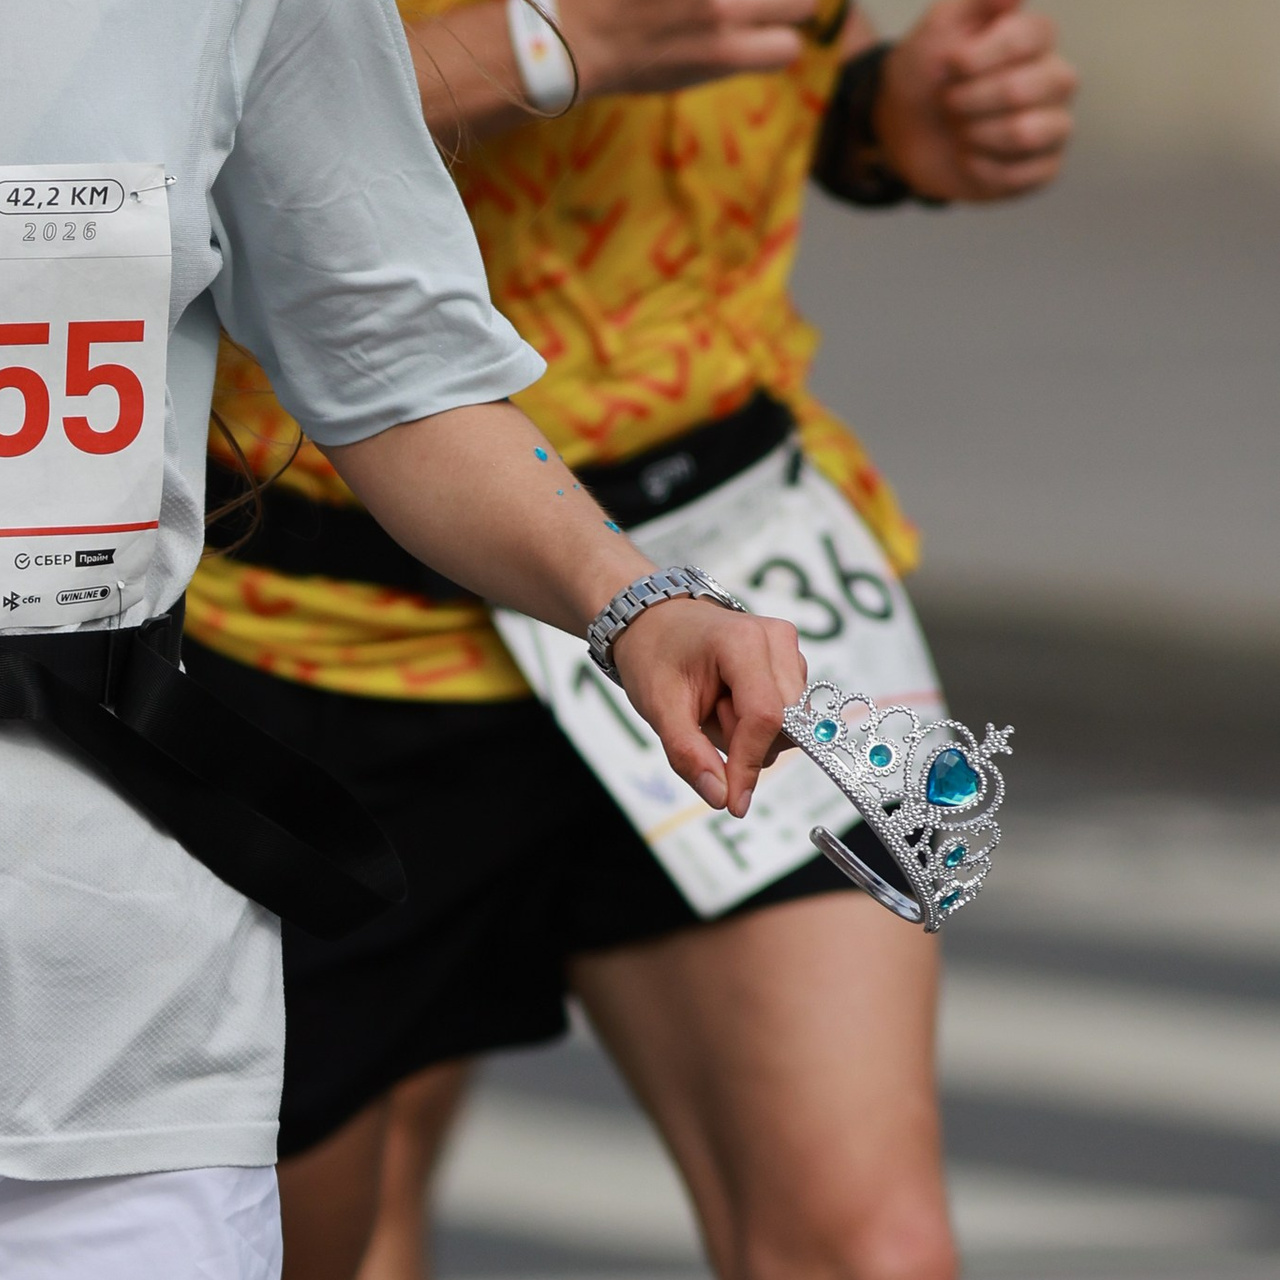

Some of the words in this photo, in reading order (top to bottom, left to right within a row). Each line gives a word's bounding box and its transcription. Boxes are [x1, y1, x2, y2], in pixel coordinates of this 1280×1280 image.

[6, 187, 60, 209] 42,2
[70, 186, 109, 206] КМ
[22, 221, 97, 242] 2026
[34, 554, 72, 566] СБЕР
[79, 553, 109, 563] Прайм
[60, 589, 99, 602] WINLINE
